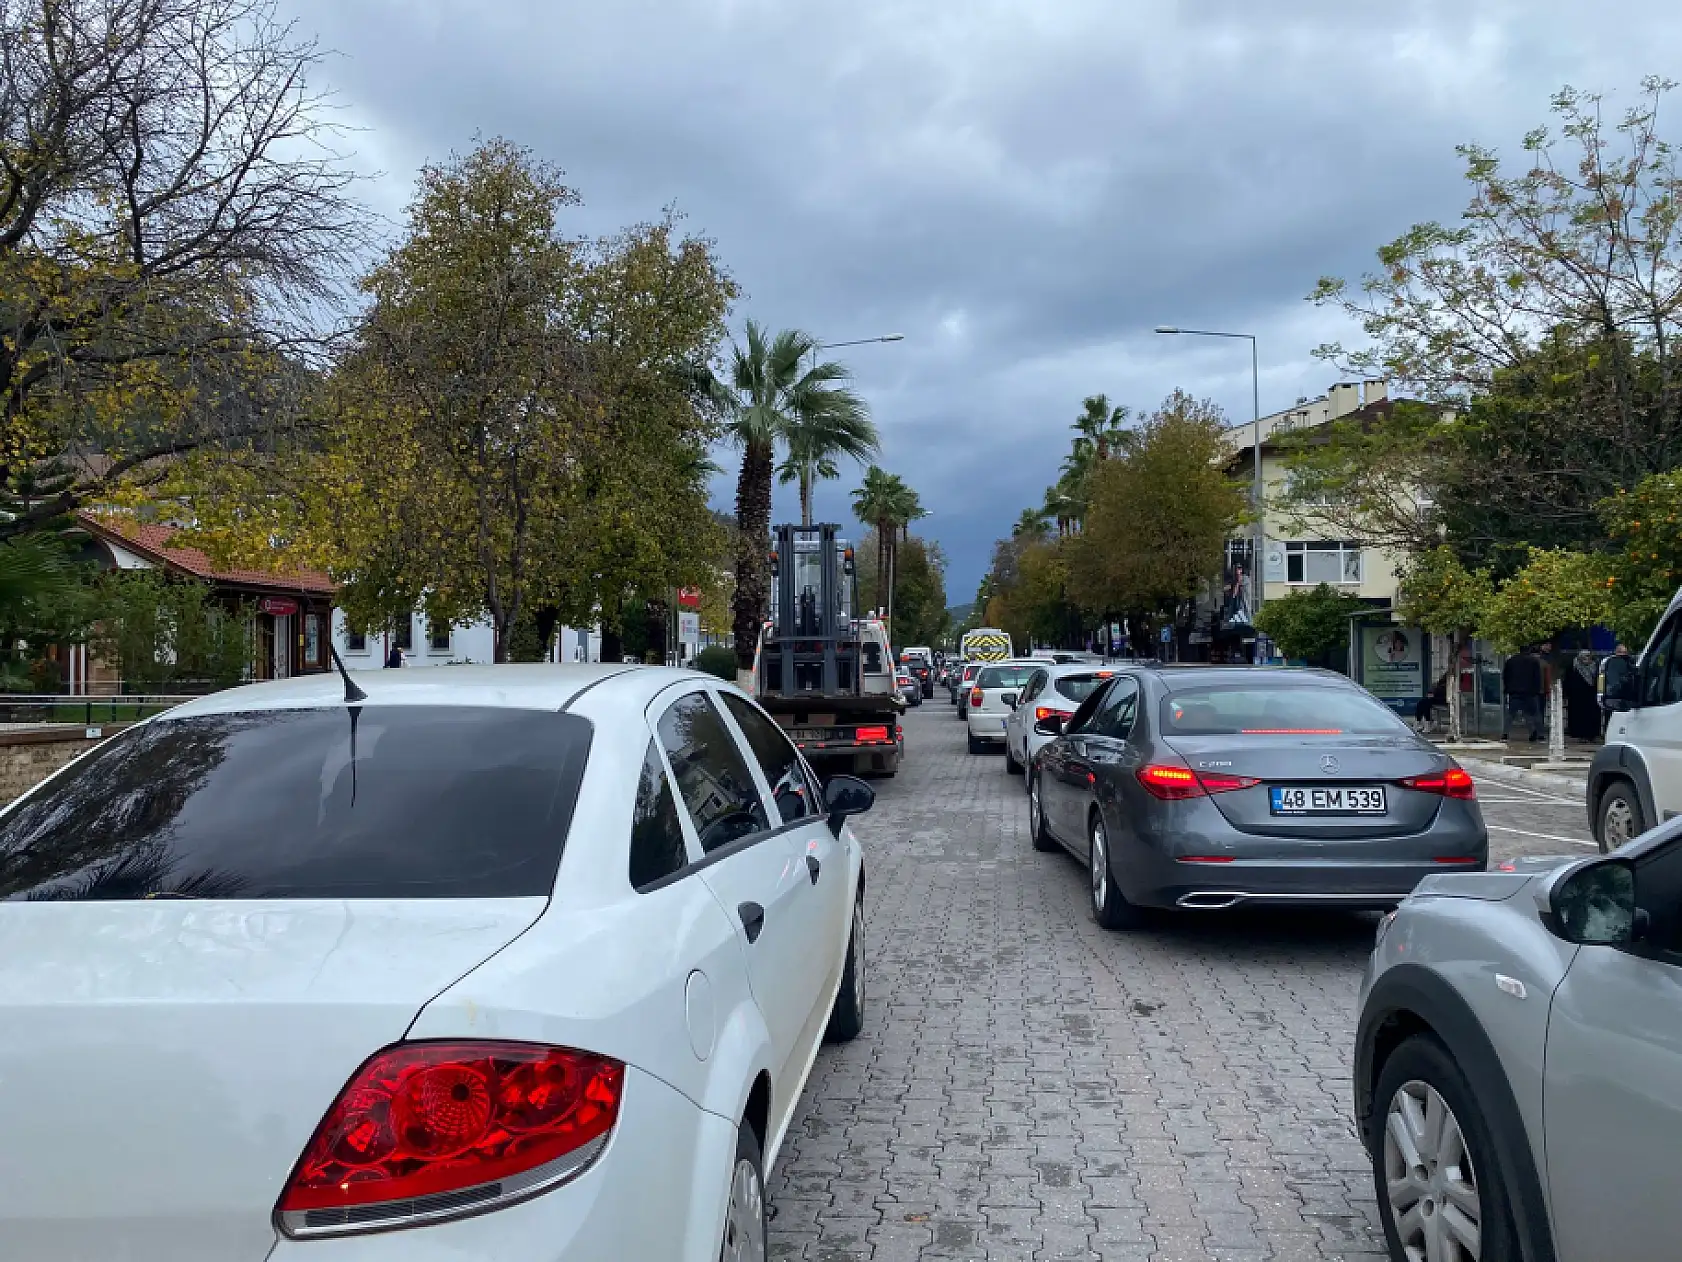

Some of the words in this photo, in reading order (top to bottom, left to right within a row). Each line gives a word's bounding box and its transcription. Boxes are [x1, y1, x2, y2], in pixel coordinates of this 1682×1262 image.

[1283, 790, 1305, 808] 48
[1311, 790, 1342, 808] EM
[1348, 790, 1381, 808] 539
